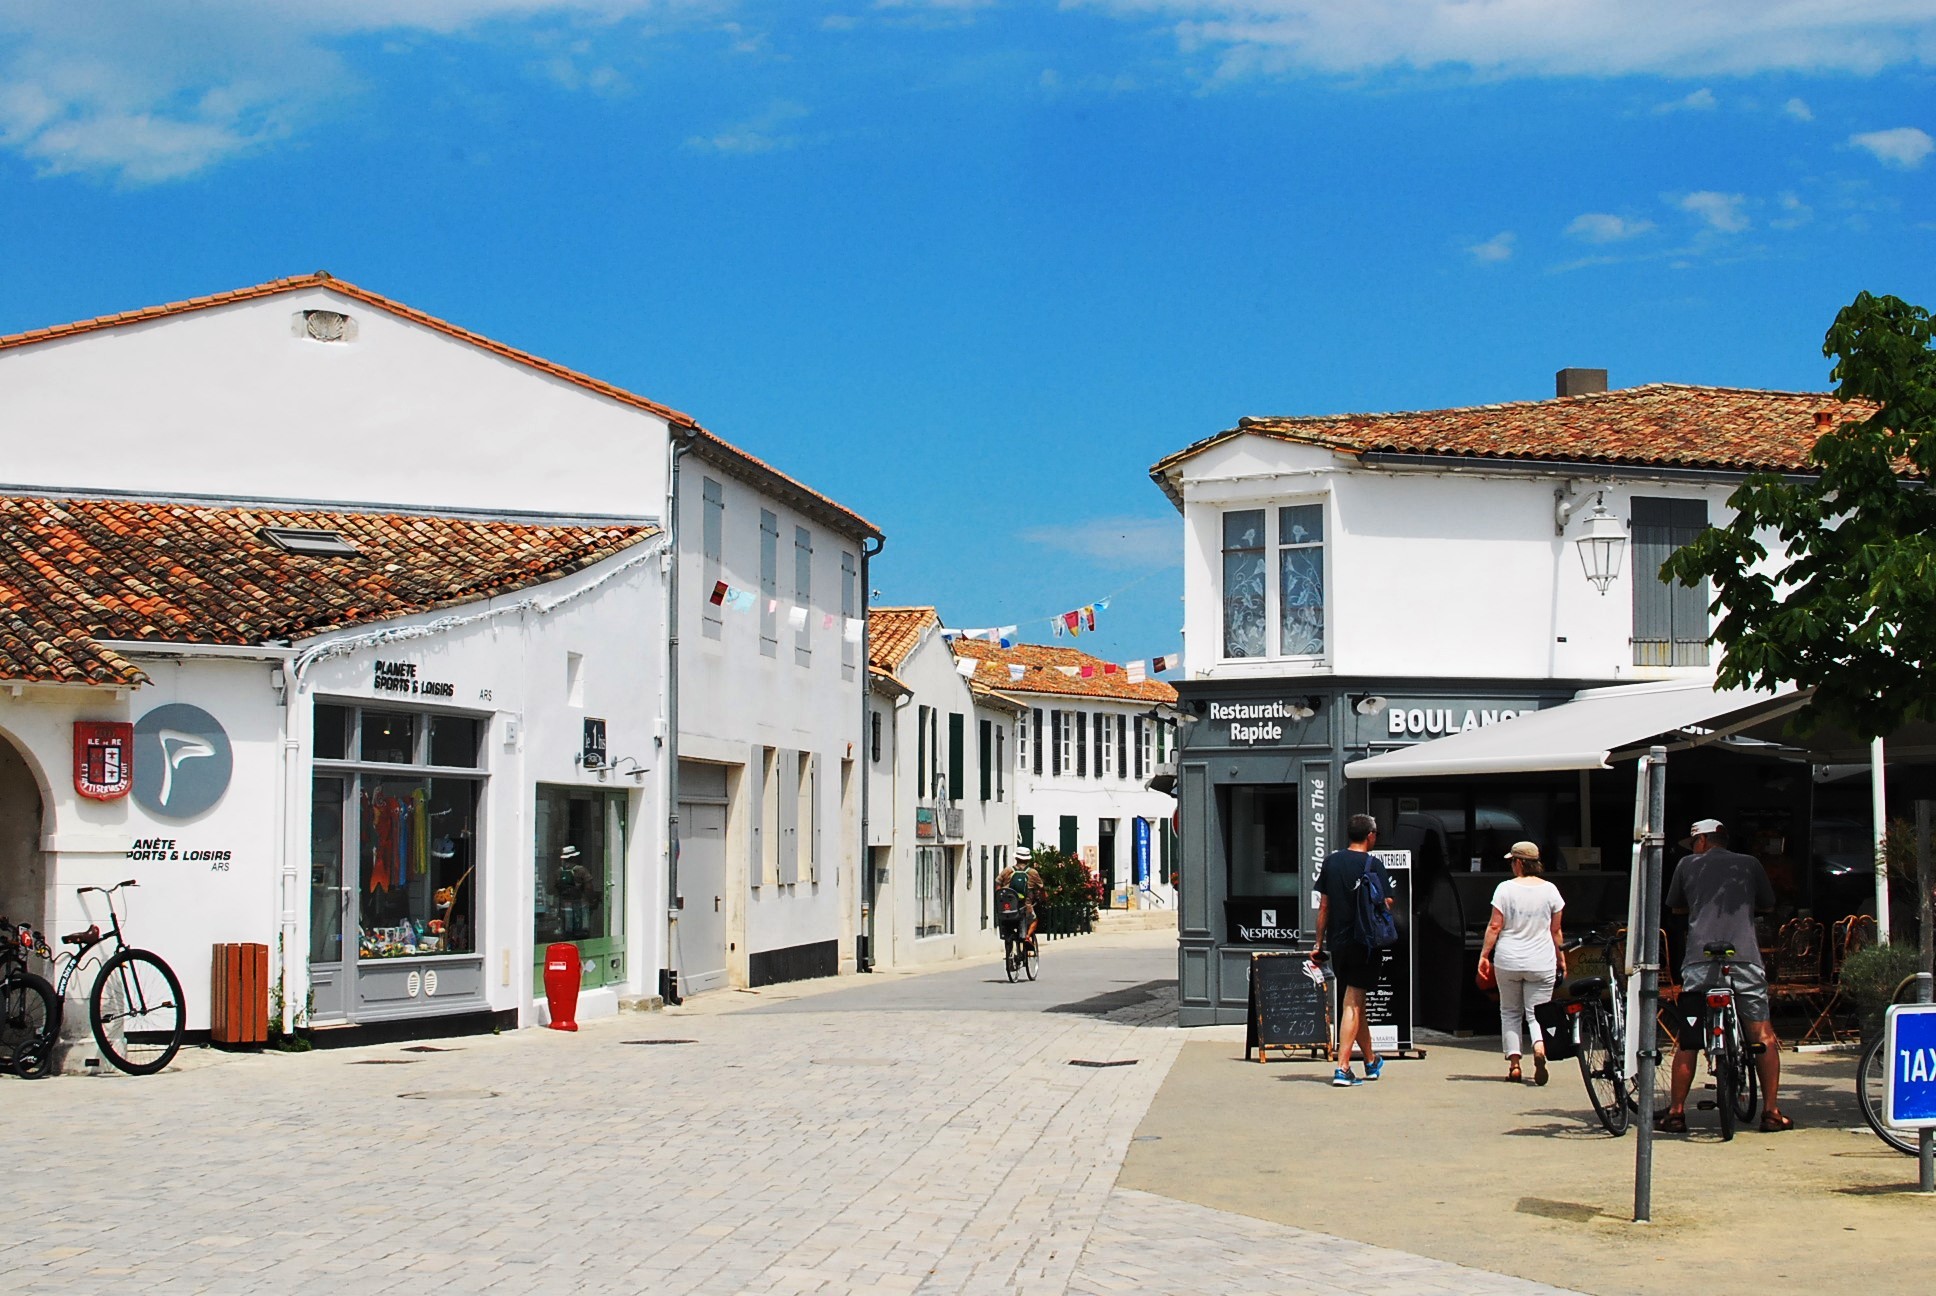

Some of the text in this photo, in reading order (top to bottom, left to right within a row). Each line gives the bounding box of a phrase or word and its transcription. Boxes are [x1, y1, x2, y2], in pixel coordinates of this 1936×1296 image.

[374, 675, 454, 697] SPORTS & LOISIRS
[479, 689, 493, 701] ARS
[593, 725, 597, 749] 1
[1231, 721, 1282, 744] Rapide
[1311, 779, 1325, 882] Salon de Thé
[170, 851, 179, 860] &
[182, 851, 232, 860] LOISIRS
[211, 862, 230, 872] ARS
[1237, 924, 1300, 942] NESPRESSO
